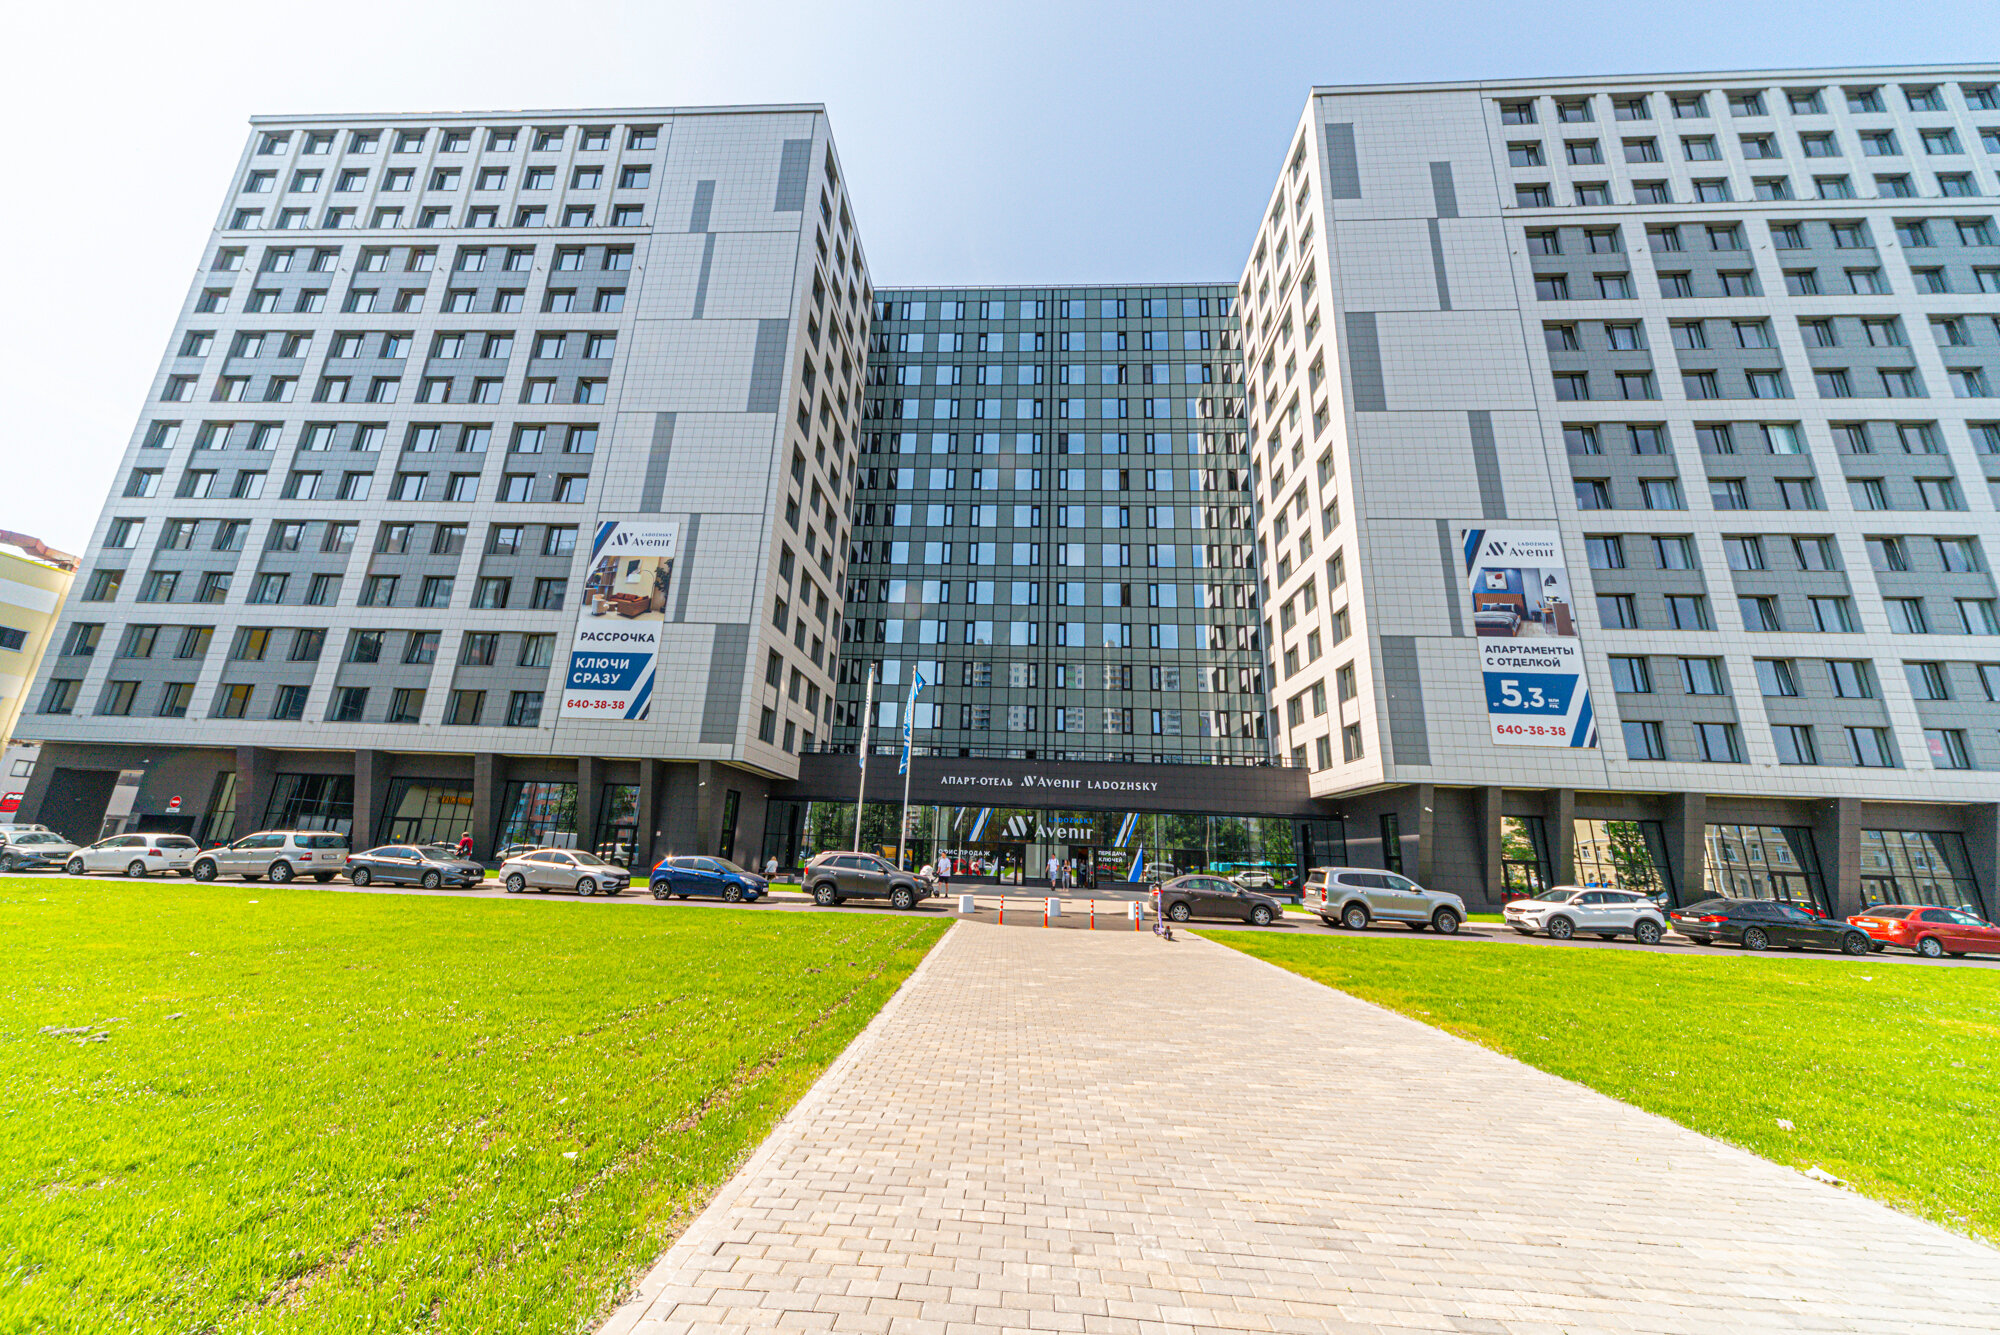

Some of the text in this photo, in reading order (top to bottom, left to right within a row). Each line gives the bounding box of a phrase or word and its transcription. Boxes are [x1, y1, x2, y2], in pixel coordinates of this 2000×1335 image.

[631, 537, 671, 547] Avenir
[1509, 547, 1555, 557] Avenir
[580, 632, 655, 643] РАССРОЧКА
[1485, 645, 1574, 656] АПАРТАМЕНТЫ
[575, 657, 630, 670] КЛЮЧИ
[1487, 656, 1561, 668] С ОТДЕЛКОЙ
[572, 672, 621, 685] СРАЗУ
[1500, 679, 1545, 709] 5,3
[567, 699, 625, 710] 640-38-38
[1496, 724, 1567, 737] 640-38-38
[940, 775, 1158, 791] АПАРТ-ОТЕЛЬ Avenir LADOZHSKY
[1034, 823, 1094, 840] Avenir
